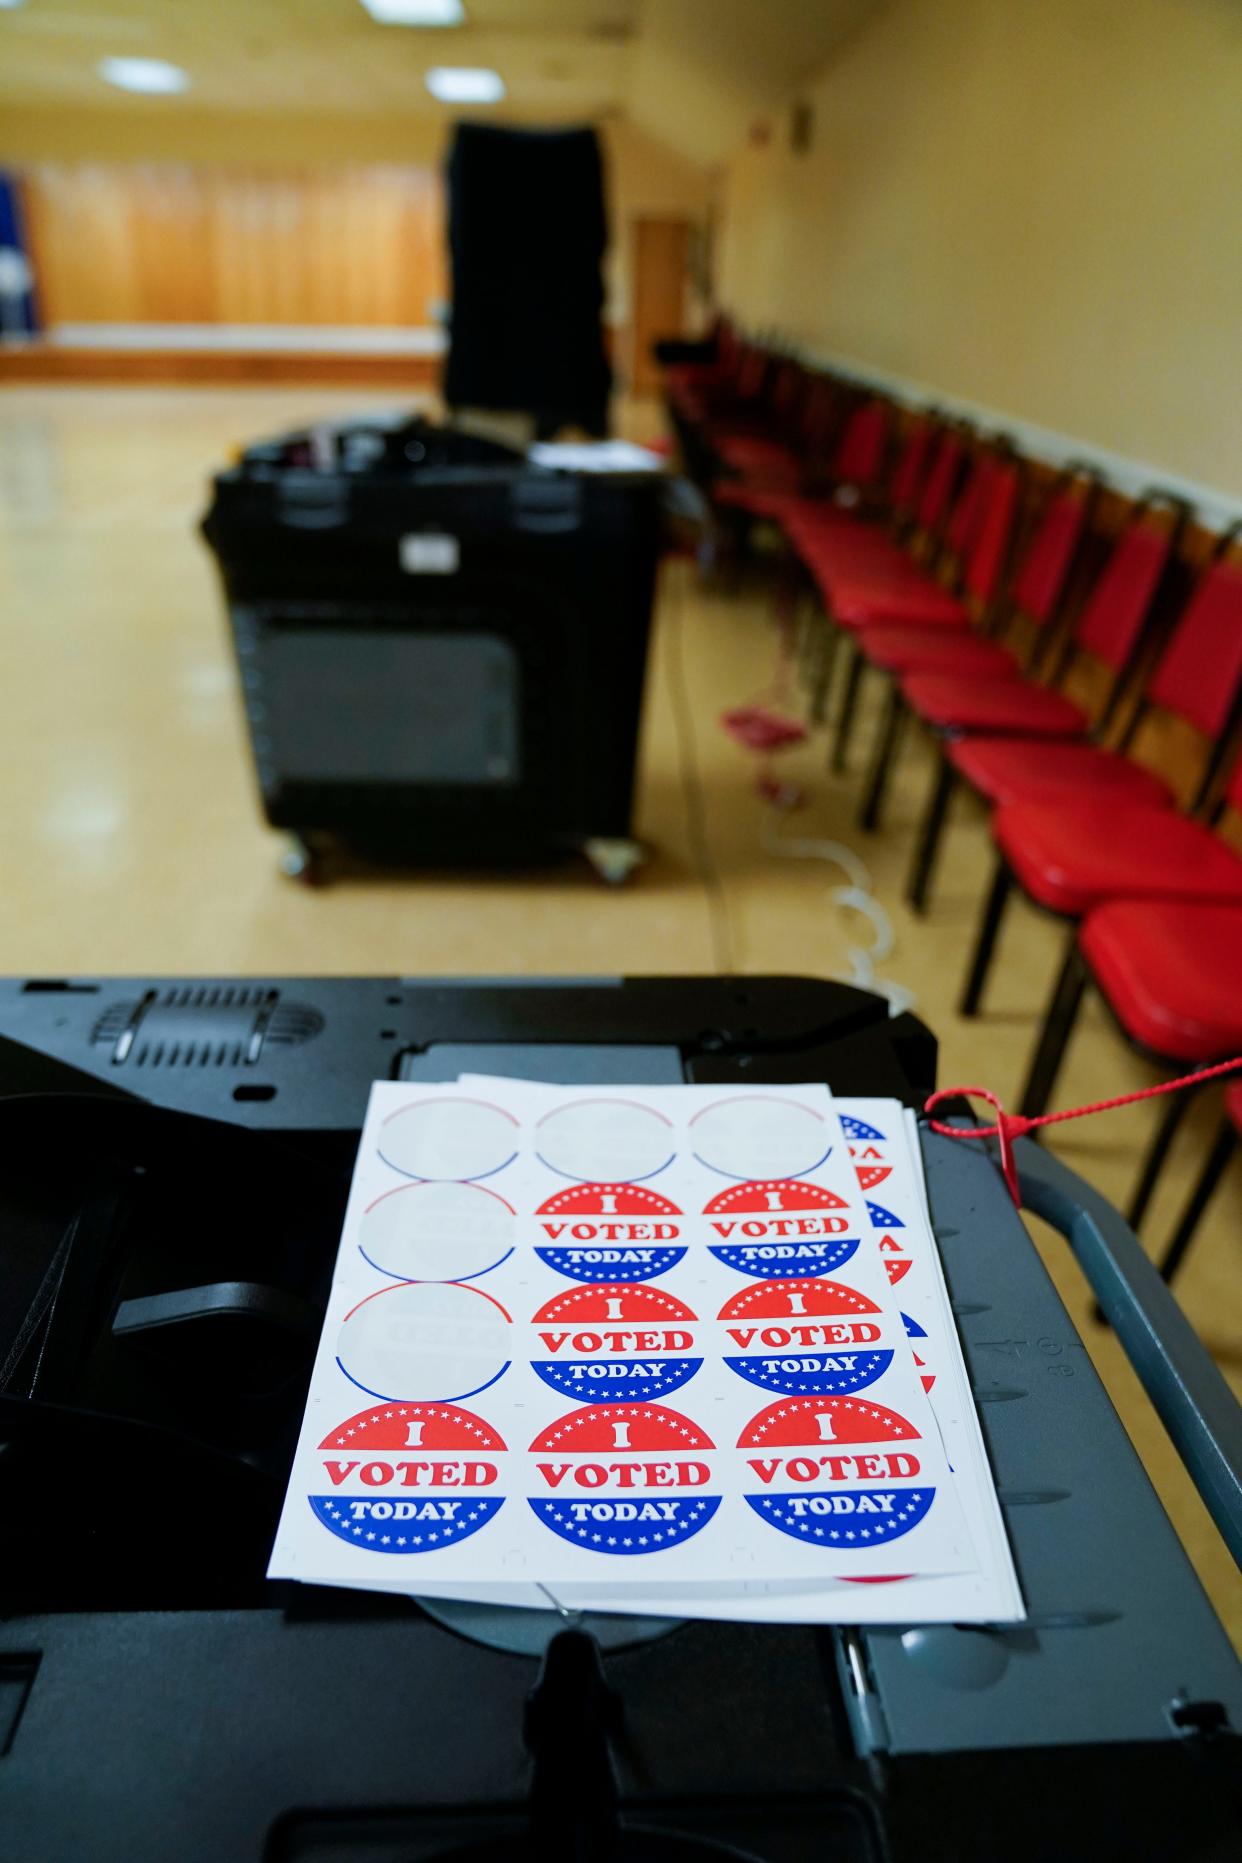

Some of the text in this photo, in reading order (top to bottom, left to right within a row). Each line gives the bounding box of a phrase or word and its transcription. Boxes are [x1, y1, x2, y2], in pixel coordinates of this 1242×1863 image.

[601, 1195, 618, 1213] I
[767, 1192, 784, 1210] I
[543, 1224, 679, 1240] VOTED
[712, 1218, 848, 1237] VOTED
[567, 1250, 655, 1263] TODAY
[741, 1244, 827, 1259] TODAY
[606, 1298, 623, 1319] I
[787, 1293, 807, 1313] I
[538, 1331, 693, 1352] VOTED
[726, 1323, 881, 1348] VOTED
[569, 1364, 666, 1378] TODAY
[762, 1356, 857, 1373] TODAY
[405, 1422, 425, 1446] I
[612, 1422, 631, 1447] I
[815, 1414, 836, 1440] I
[323, 1461, 497, 1486] VOTED
[536, 1462, 710, 1488] VOTED
[747, 1453, 920, 1483] VOTED
[350, 1502, 461, 1520] TODAY
[571, 1503, 680, 1521] TODAY
[788, 1495, 895, 1515] TODAY
